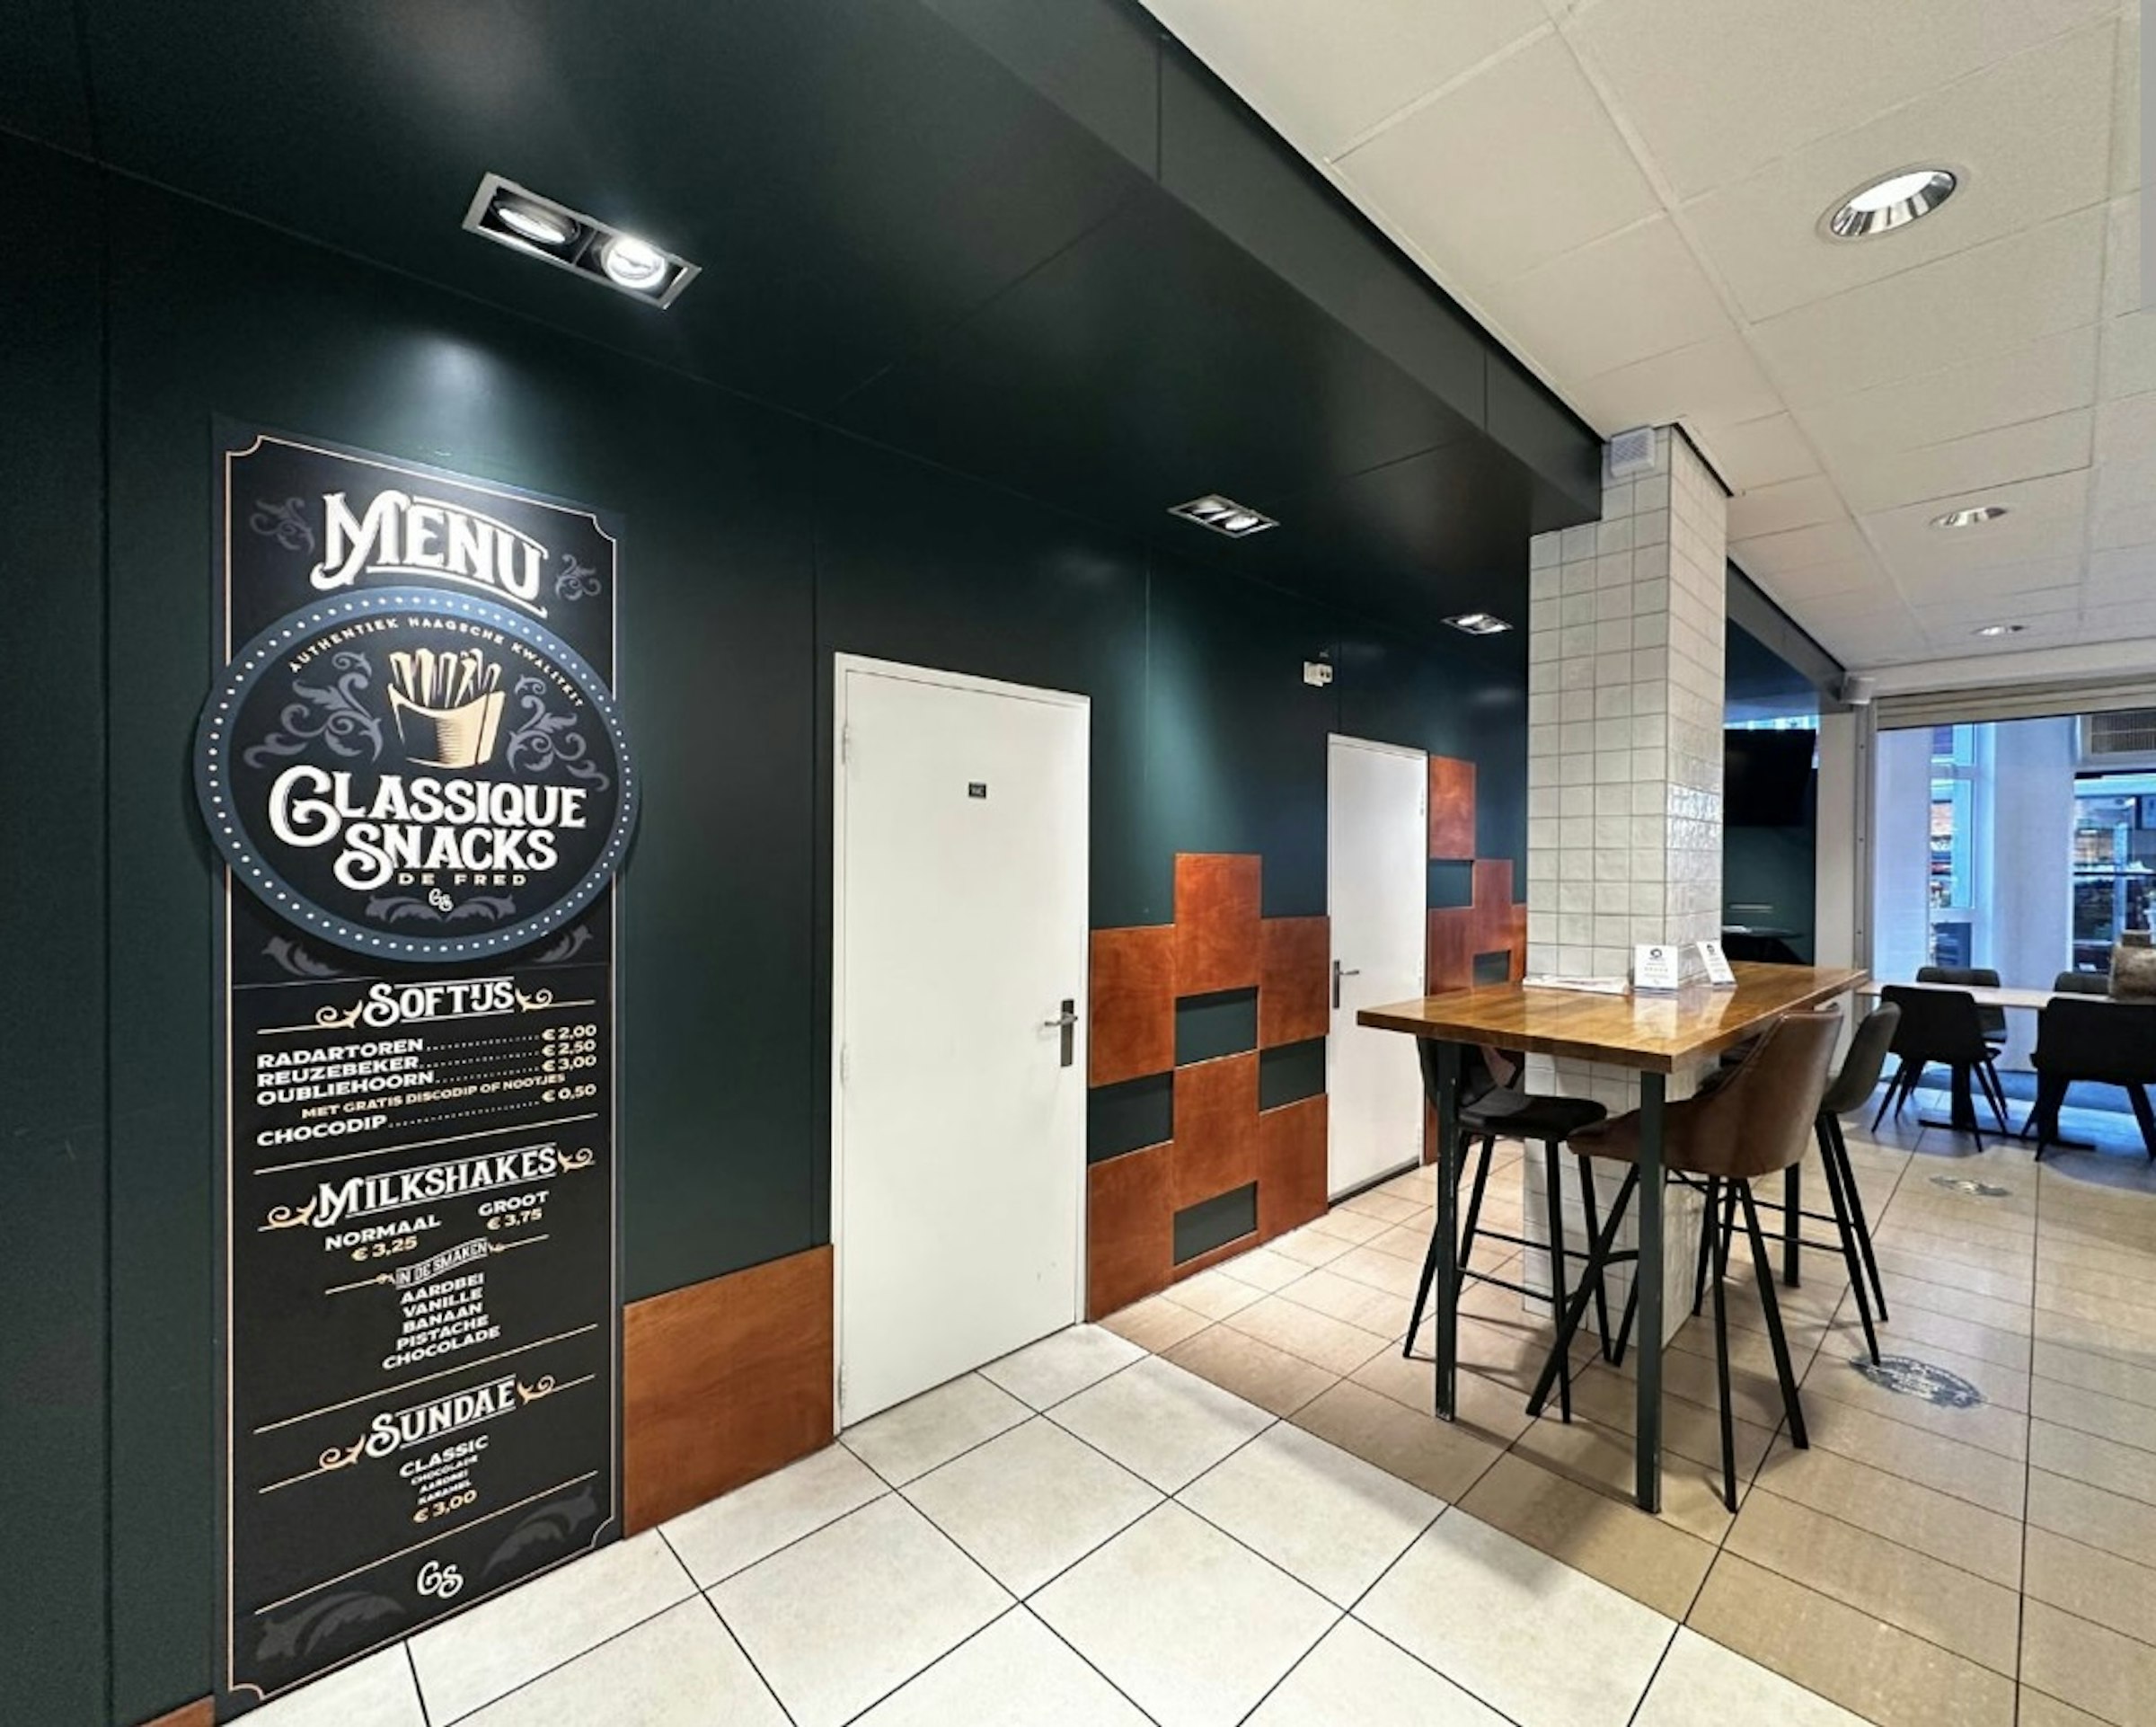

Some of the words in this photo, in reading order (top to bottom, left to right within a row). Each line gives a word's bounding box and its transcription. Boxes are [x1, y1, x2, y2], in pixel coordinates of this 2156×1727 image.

[310, 489, 544, 603] MENU
[288, 616, 399, 674] AUTHENTIEK
[269, 765, 587, 846] CLASSIQUE
[333, 824, 558, 890] SNACKS
[398, 872, 435, 886] DE
[454, 873, 527, 886] FRED
[257, 1038, 423, 1069] RADARTOREN
[541, 1028, 556, 1041] €
[257, 1056, 420, 1087] REUZEBEKER
[541, 1043, 556, 1058] €
[257, 1070, 434, 1105] OUBLIEHOORN
[541, 1058, 556, 1072] €
[302, 1103, 340, 1119] MET
[342, 1095, 403, 1113] GRATIS
[405, 1085, 477, 1104] DISCODIP
[480, 1081, 501, 1094] OF
[502, 1073, 565, 1091] NOOTJES
[257, 1114, 387, 1147] CHOCODIP
[541, 1089, 556, 1103] €
[312, 1147, 558, 1228] MILKSHAKES
[478, 1191, 550, 1217] GROOT
[324, 1215, 442, 1251] NORMAAL
[486, 1217, 501, 1230] €
[351, 1246, 368, 1262] €
[396, 1268, 411, 1285] IN
[432, 1241, 488, 1271] SMAKEN
[400, 1272, 484, 1306] AARDBEI
[402, 1287, 483, 1318] VANILLE
[396, 1314, 489, 1351] PISTACHE
[402, 1302, 483, 1334] BANAAN
[382, 1324, 501, 1369] CHOCOLADE
[365, 1379, 516, 1458] SUNDAE
[399, 1435, 489, 1477] CLASSIC
[413, 1507, 429, 1523] €
